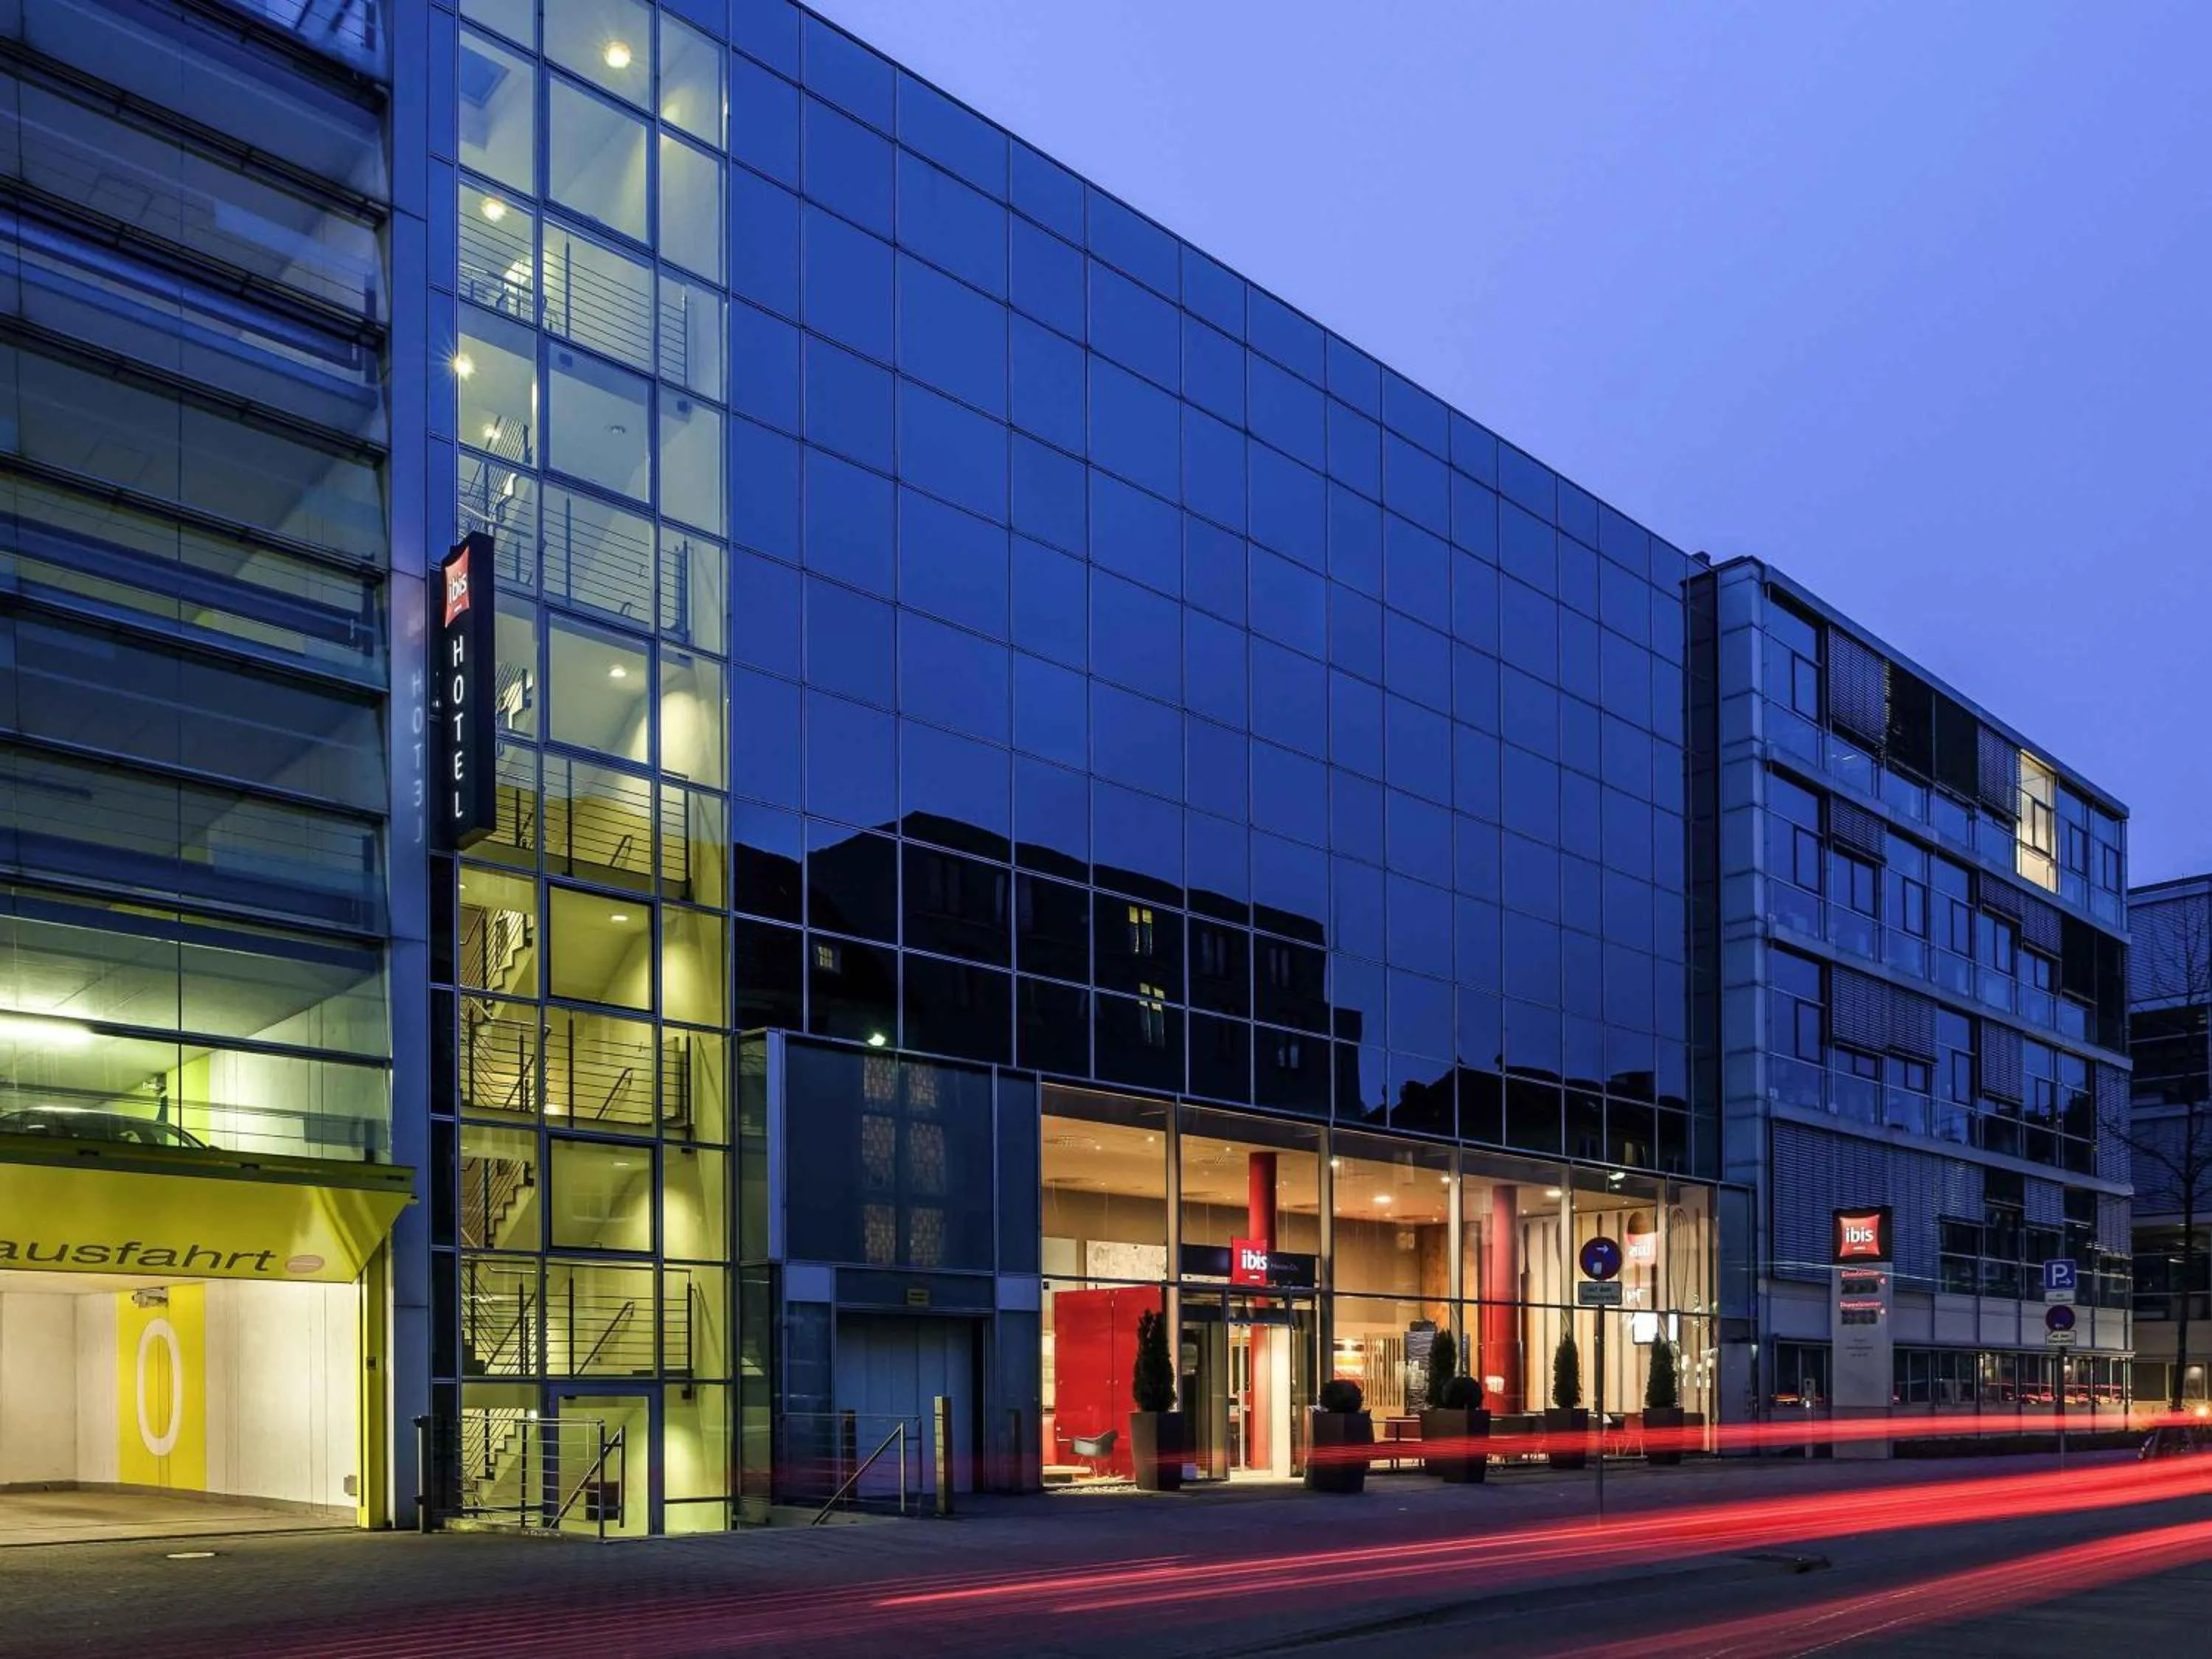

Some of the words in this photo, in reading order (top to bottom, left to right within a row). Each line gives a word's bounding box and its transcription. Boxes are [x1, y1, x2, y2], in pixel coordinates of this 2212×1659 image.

[448, 574, 467, 604] ibis
[453, 635, 464, 818] HOTEL
[1845, 1227, 1874, 1243] ibis
[1241, 1249, 1267, 1270] ibis
[2051, 1264, 2068, 1286] P
